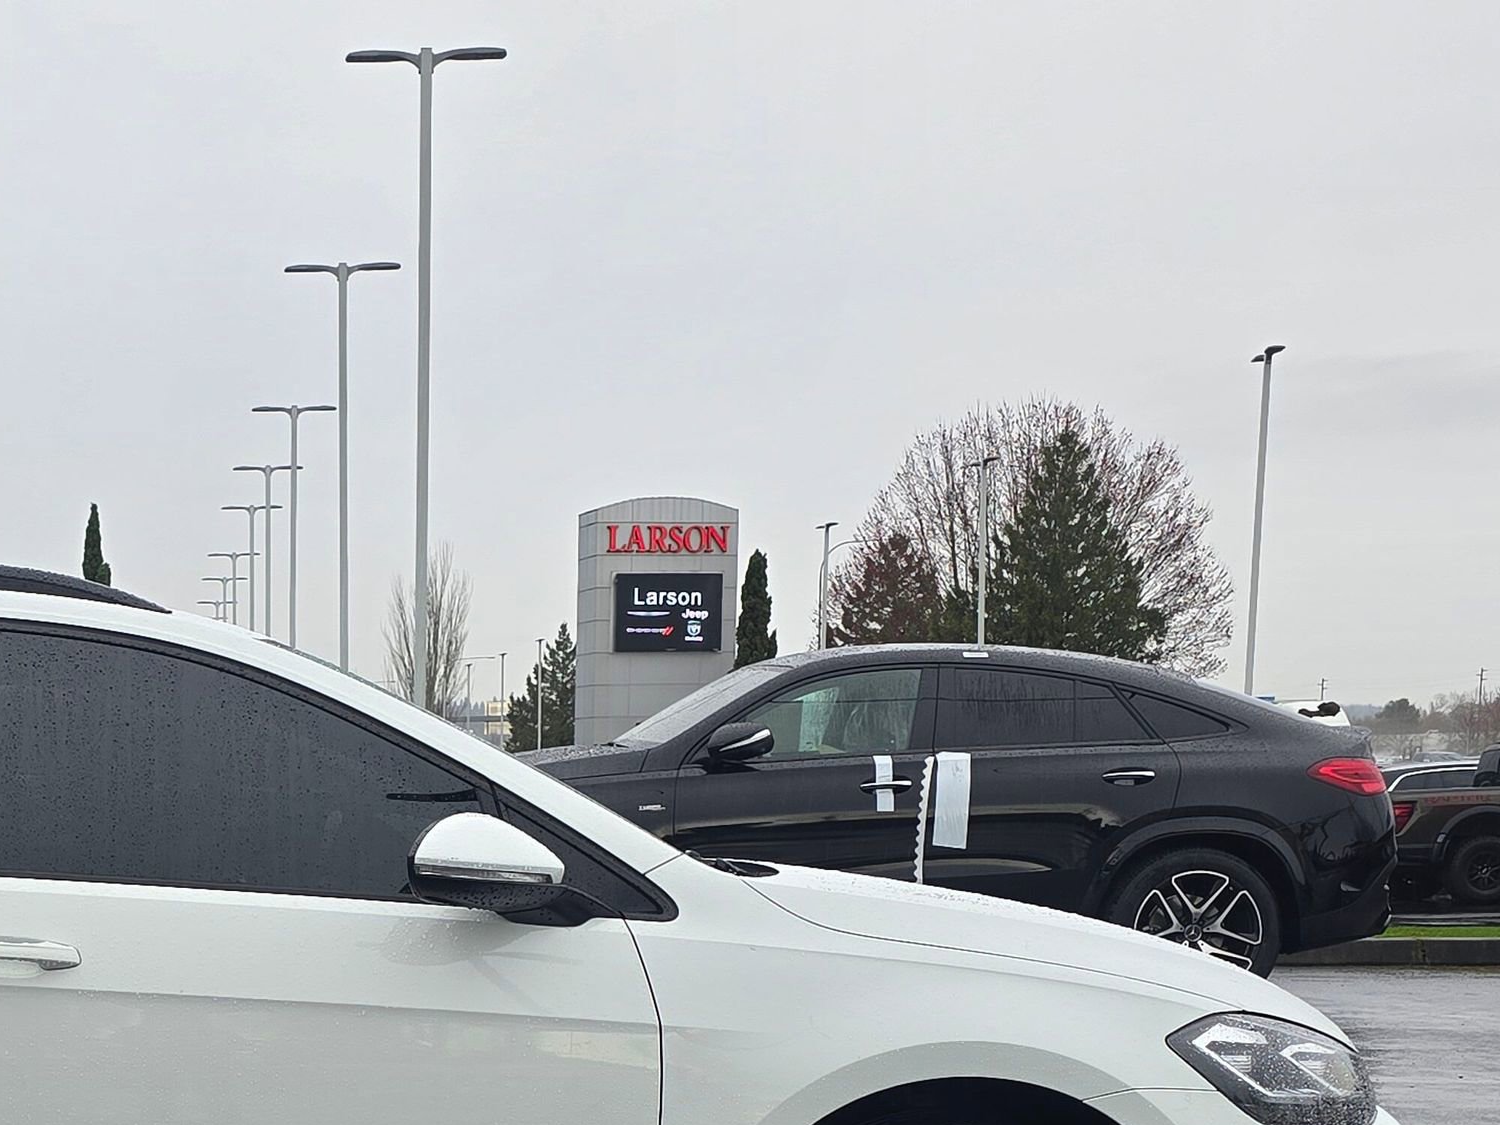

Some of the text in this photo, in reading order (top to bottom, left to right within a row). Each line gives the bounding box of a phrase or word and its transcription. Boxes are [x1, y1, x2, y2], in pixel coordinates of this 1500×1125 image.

[606, 525, 730, 553] LARSON
[633, 587, 701, 605] Larson
[681, 608, 709, 620] Jeep
